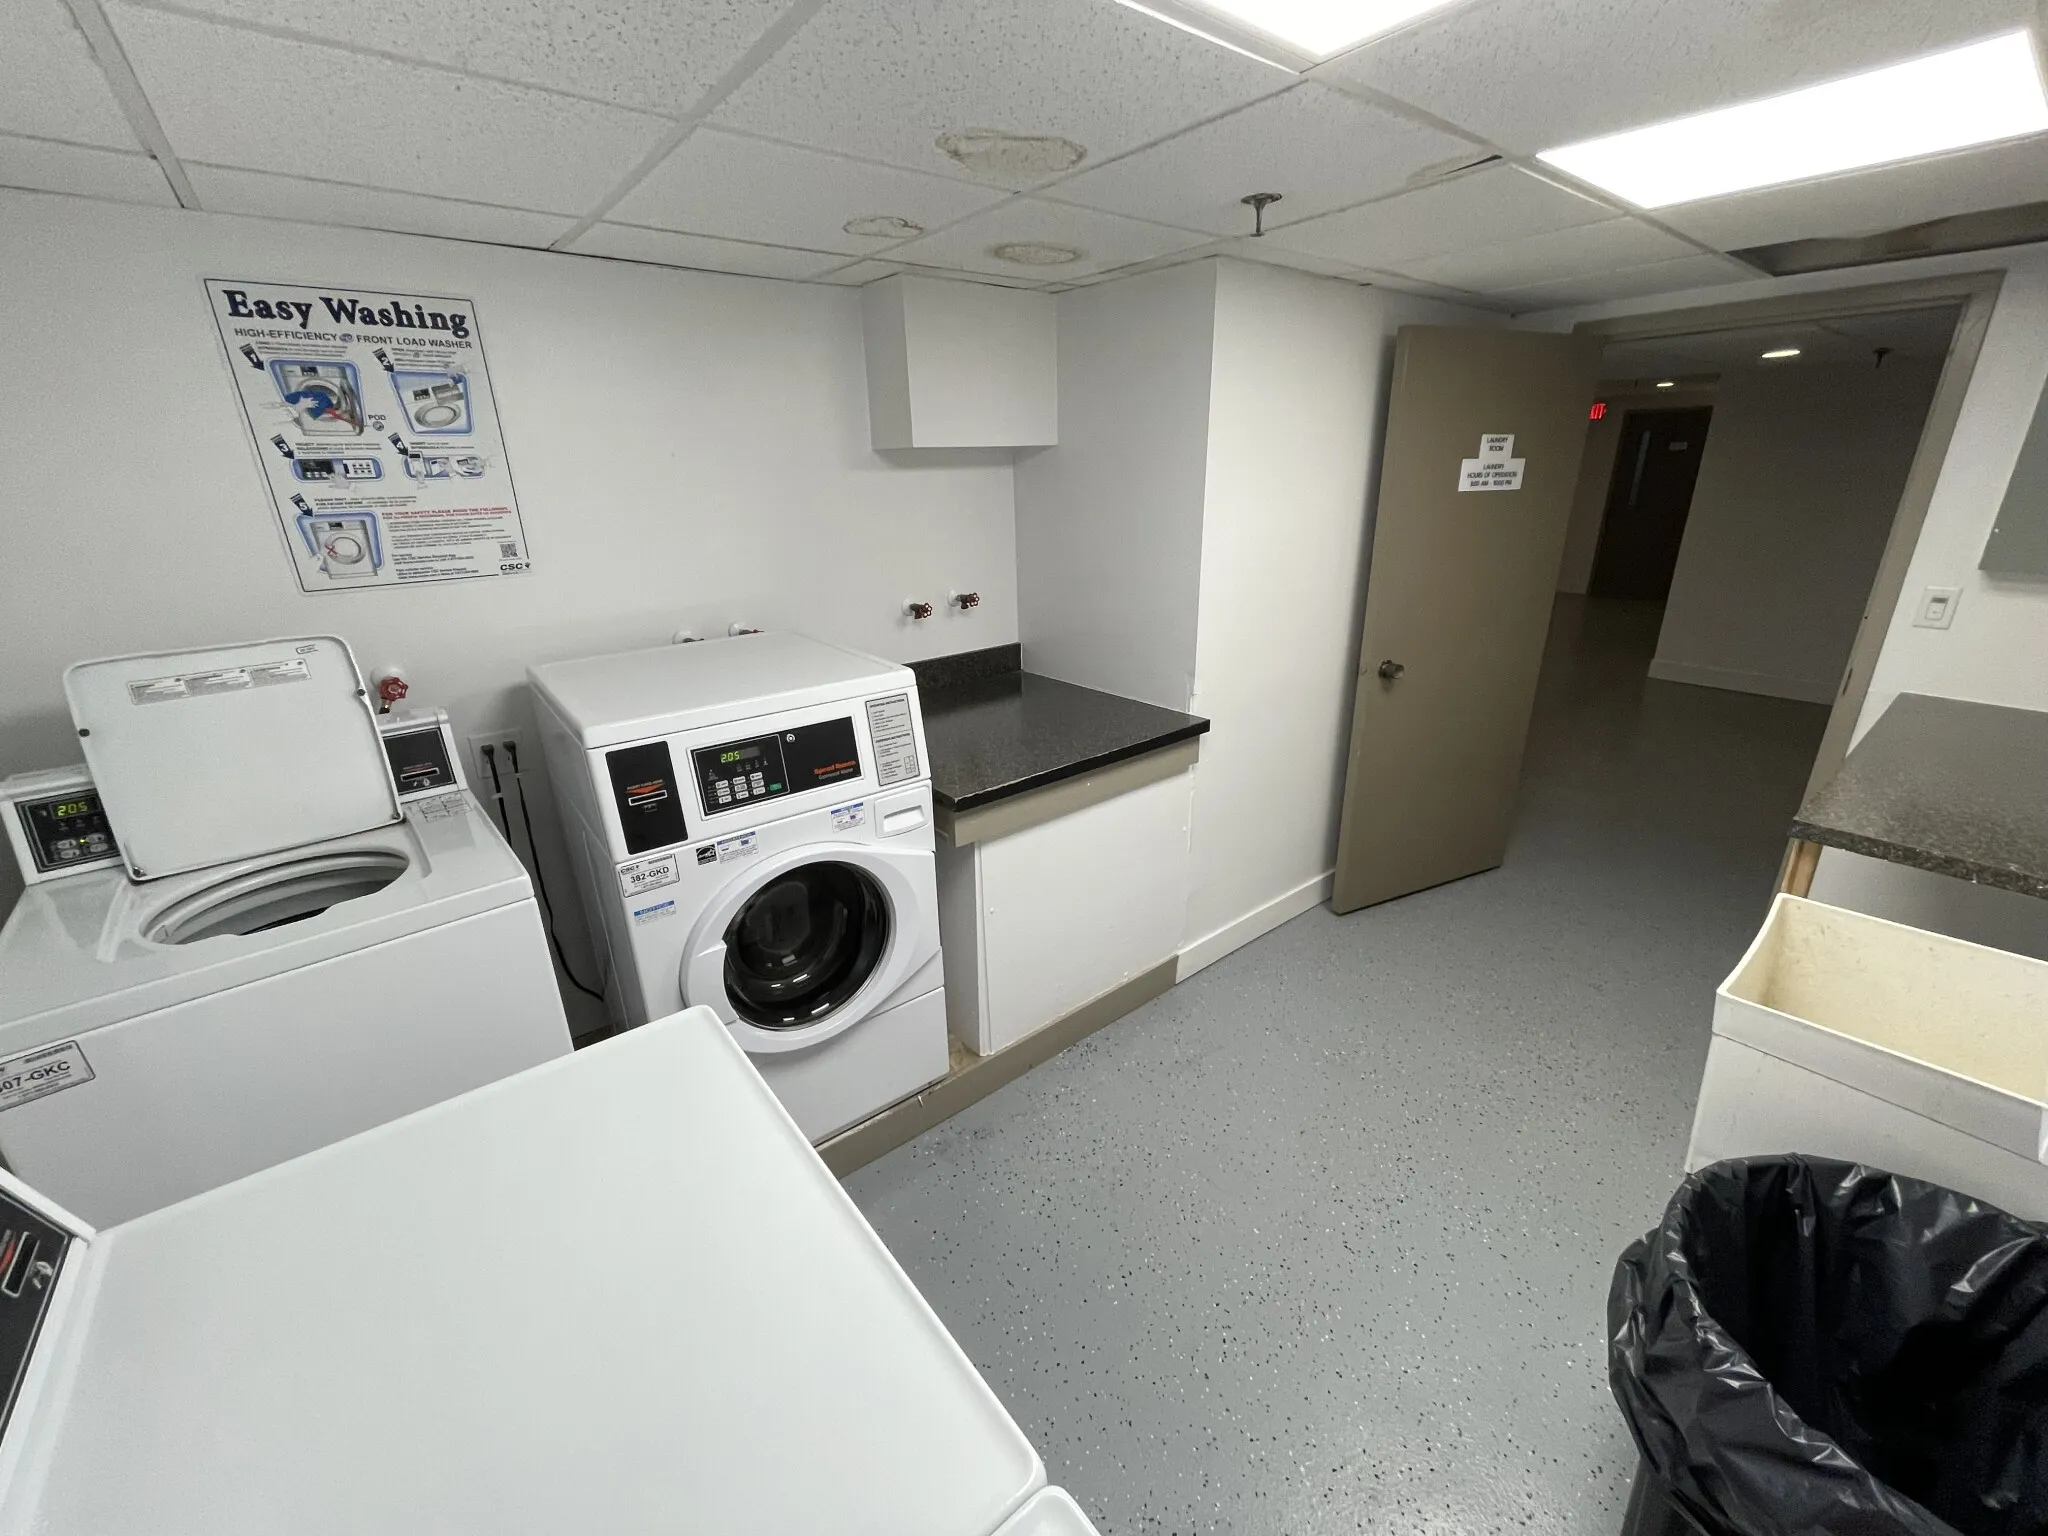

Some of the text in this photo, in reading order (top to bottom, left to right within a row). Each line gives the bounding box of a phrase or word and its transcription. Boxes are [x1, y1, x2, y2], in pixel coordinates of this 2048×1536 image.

[222, 289, 470, 339] Easy Washing
[234, 328, 472, 349] HIGH-EFFICIENCY FRONT LOAD WASHER
[500, 562, 523, 571] CSC
[630, 866, 670, 883] 382-GKD
